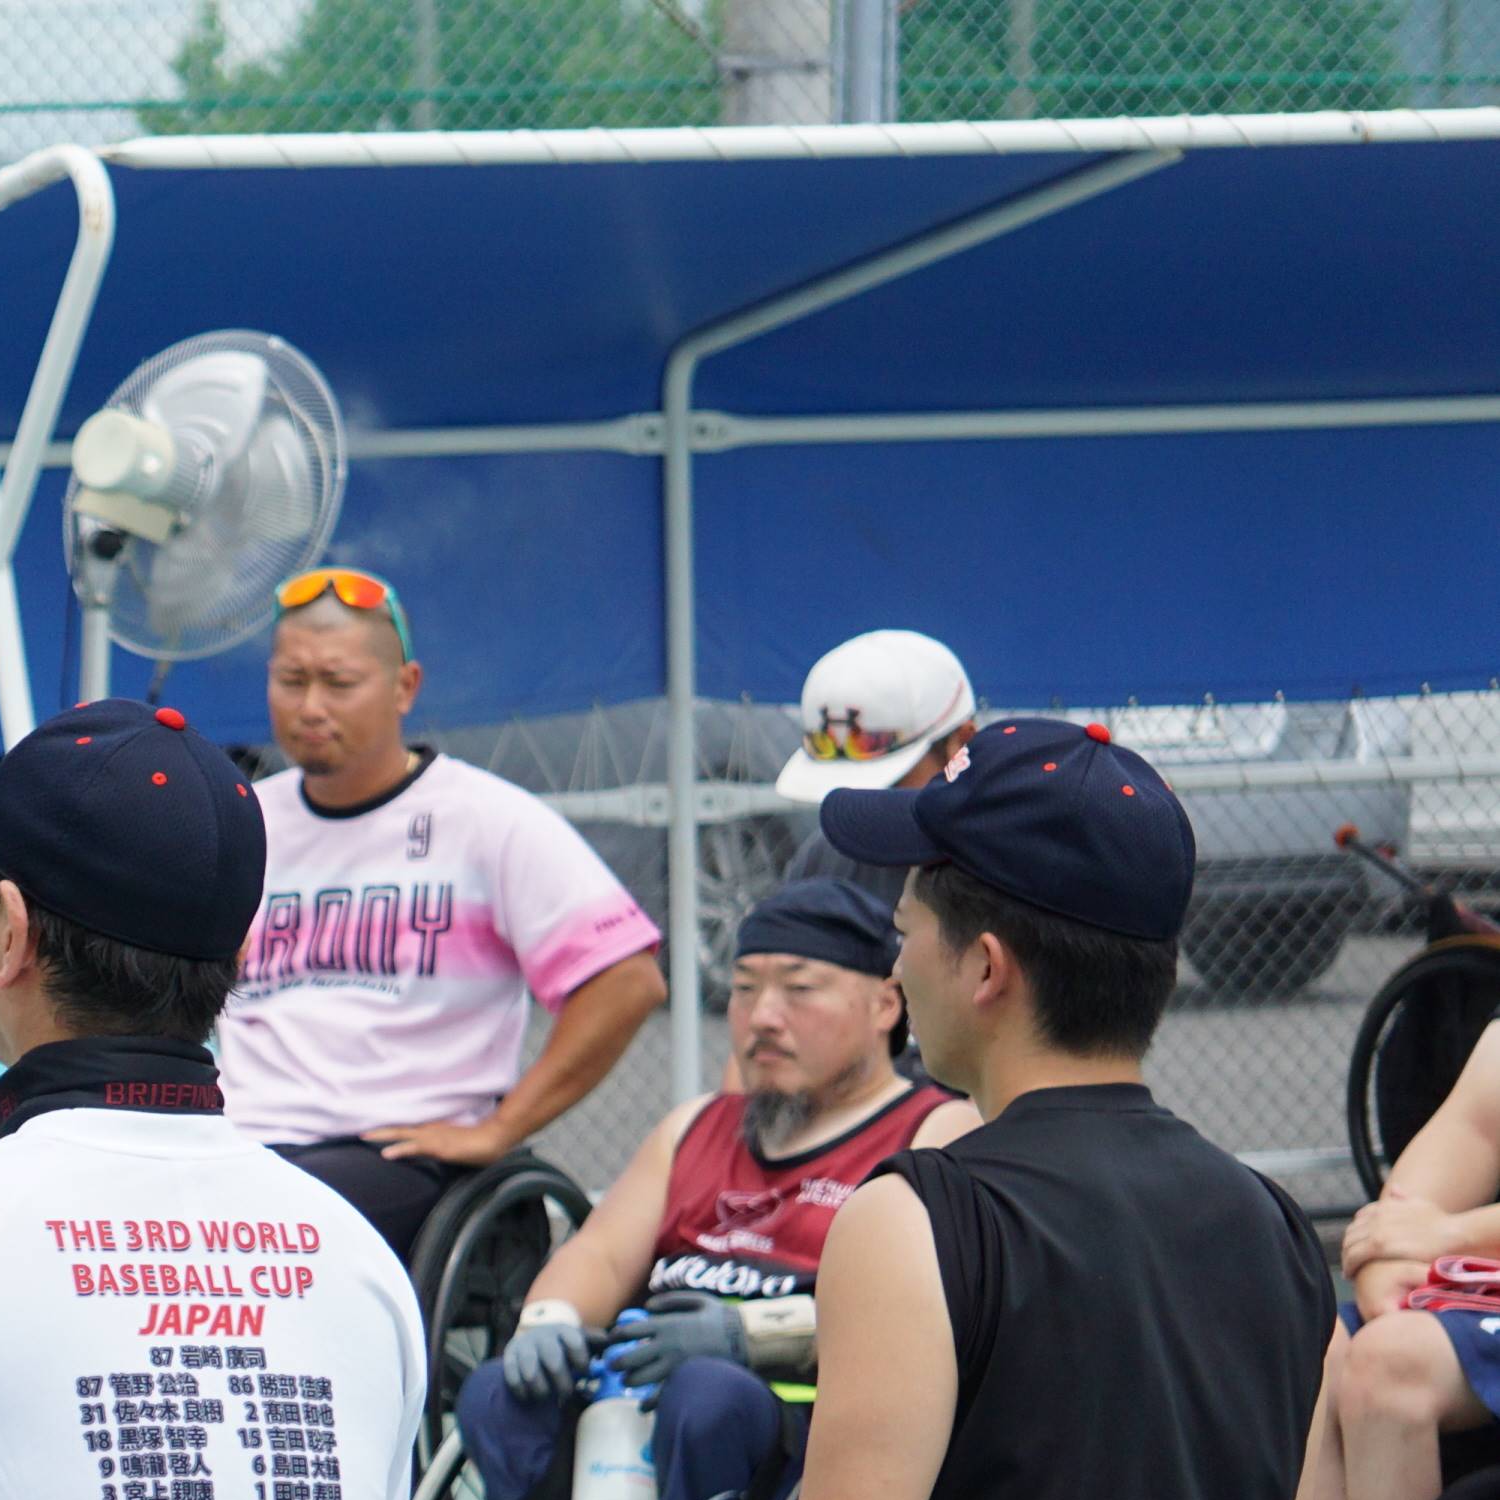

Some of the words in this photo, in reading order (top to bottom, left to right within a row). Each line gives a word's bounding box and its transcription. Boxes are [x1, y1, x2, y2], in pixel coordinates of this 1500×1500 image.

[406, 811, 433, 860] 9
[45, 1220, 117, 1252] THE
[123, 1220, 192, 1252] 3RD
[198, 1220, 322, 1254] WORLD
[72, 1264, 244, 1298] BASEBALL
[250, 1265, 315, 1300] CUP
[138, 1303, 266, 1337] JAPAN
[149, 1347, 173, 1368] 87
[75, 1375, 103, 1398] 87
[227, 1374, 255, 1396] 86
[79, 1403, 107, 1425] 31
[243, 1401, 260, 1422] 2
[83, 1430, 112, 1452] 18
[237, 1428, 263, 1449] 15
[99, 1456, 115, 1479] 9
[251, 1455, 267, 1476] 6
